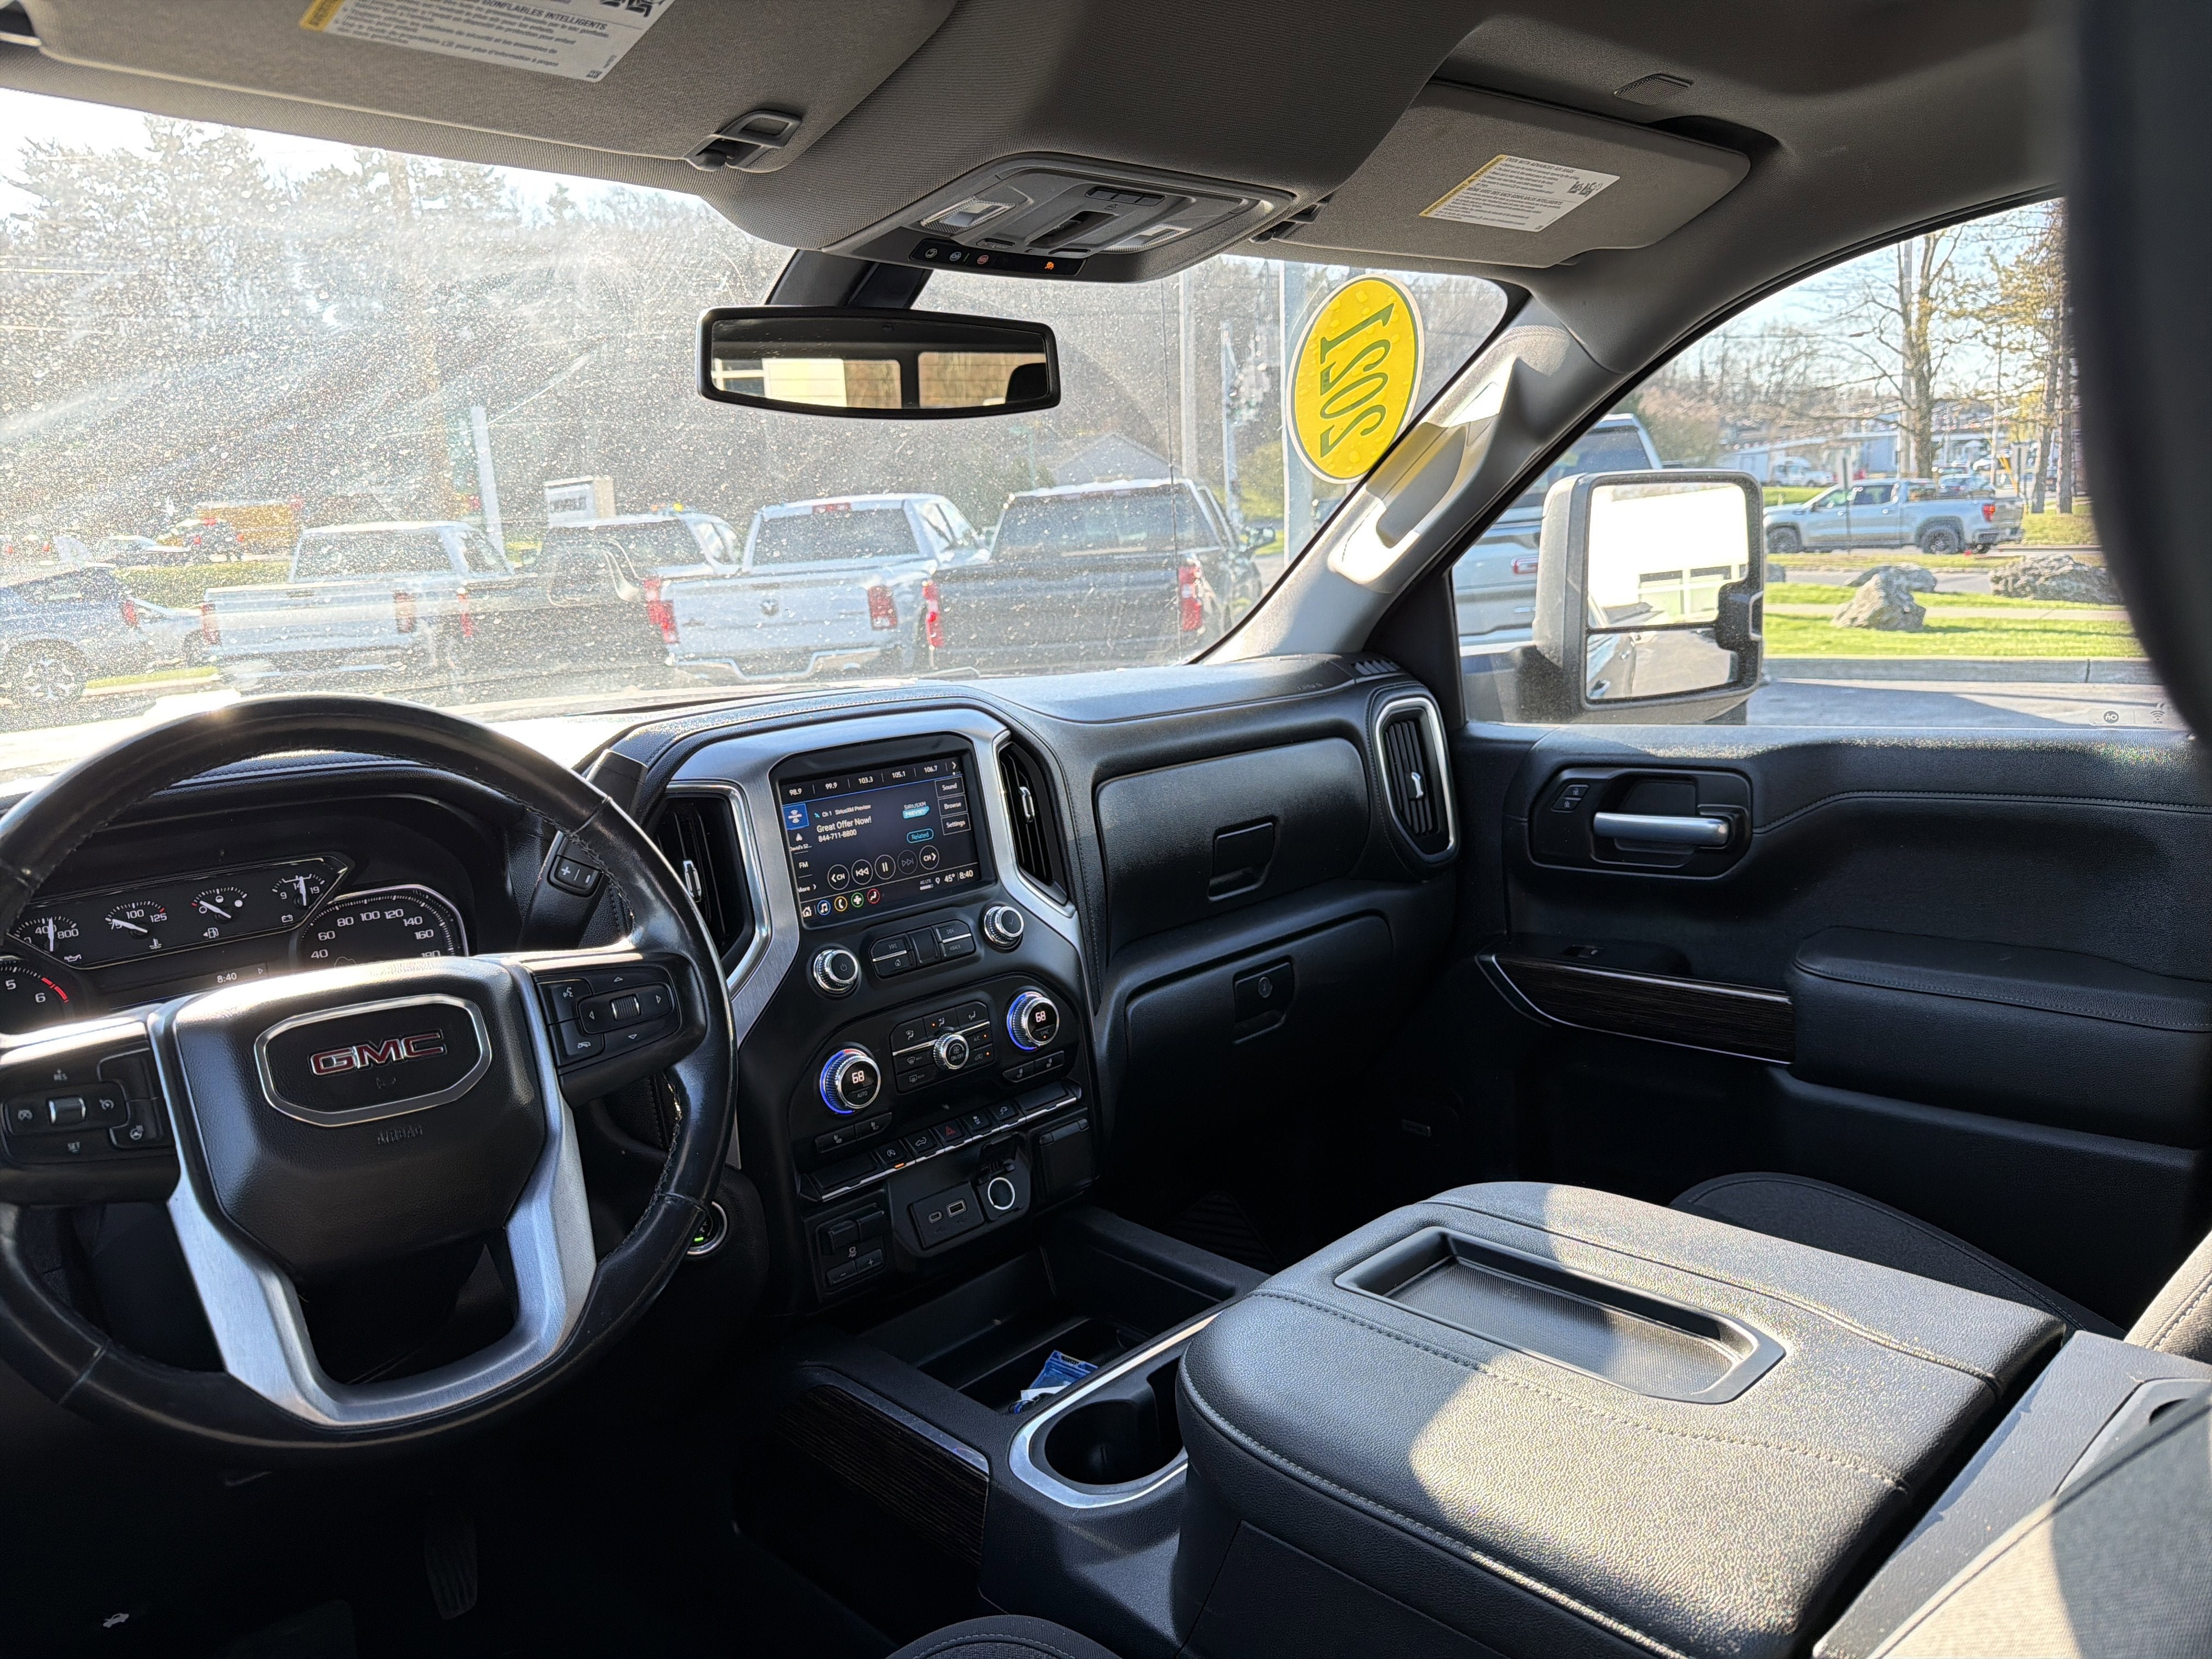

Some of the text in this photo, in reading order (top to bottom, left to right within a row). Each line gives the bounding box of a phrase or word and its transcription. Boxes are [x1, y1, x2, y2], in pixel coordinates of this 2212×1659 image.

[545, 13, 608, 30] INTELLIGENTS
[1320, 303, 1394, 458] 2021
[942, 782, 957, 791] Sound
[835, 807, 854, 815] SiriusXM
[944, 802, 962, 810] Browse
[816, 816, 872, 833] Great Offer Now!
[946, 820, 966, 828] Settings
[818, 829, 857, 843] 844-711-8800
[911, 832, 929, 840] Related
[944, 870, 973, 883] 45° 8:40
[309, 885, 320, 894] 19
[126, 909, 144, 919] 100
[150, 913, 167, 923] 125
[360, 911, 380, 921] 100
[384, 909, 404, 919] 120
[337, 917, 354, 927] 80
[403, 916, 423, 927] 140
[58, 928, 79, 939] 800
[318, 930, 336, 941] 60
[414, 929, 434, 940] 160
[311, 949, 329, 959] 40
[217, 972, 237, 983] 8:40
[5, 979, 16, 990] 5
[35, 992, 46, 1003] 6
[1035, 1011, 1046, 1023] 68
[310, 1032, 444, 1076] GMC
[951, 1053, 964, 1062] ON/OFF
[851, 1070, 865, 1084] 68
